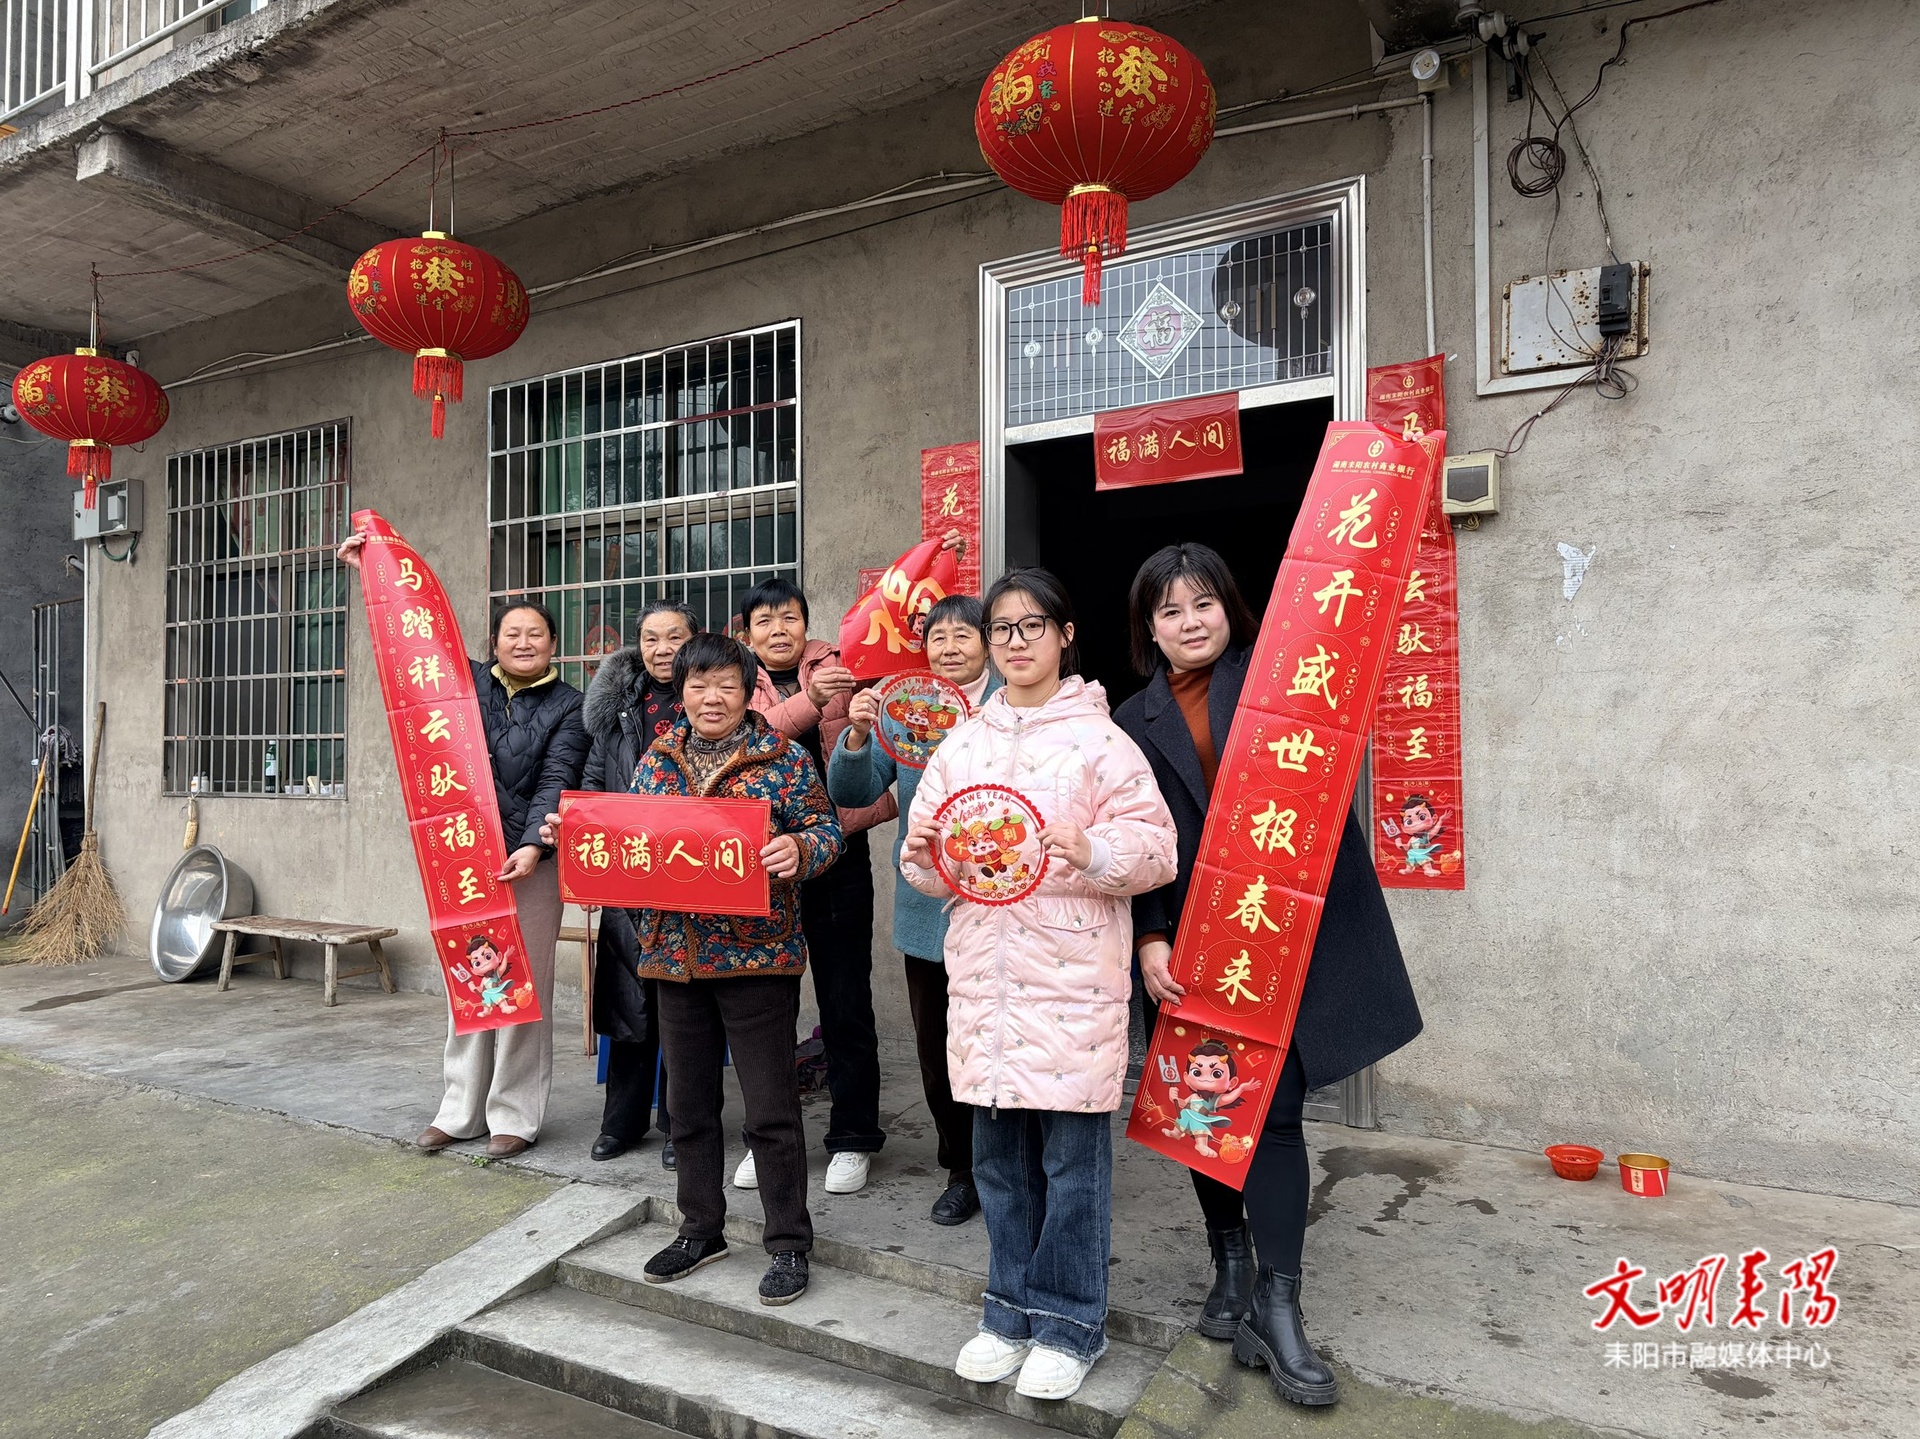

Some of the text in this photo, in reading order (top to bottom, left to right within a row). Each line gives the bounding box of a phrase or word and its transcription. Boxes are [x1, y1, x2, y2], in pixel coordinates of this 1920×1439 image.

[1107, 421, 1224, 464] 福满人间
[940, 483, 963, 517] 花
[888, 679, 912, 695] HAPPY
[936, 680, 956, 697] YEAR
[394, 557, 485, 905] 马踏祥云驮福至
[936, 713, 949, 726] 利
[1214, 488, 1378, 1006] 花开盛世报春来
[959, 791, 982, 806] NWE
[986, 790, 1011, 803] YEAR
[1002, 827, 1018, 842] 利
[576, 832, 744, 878] 福满人间
